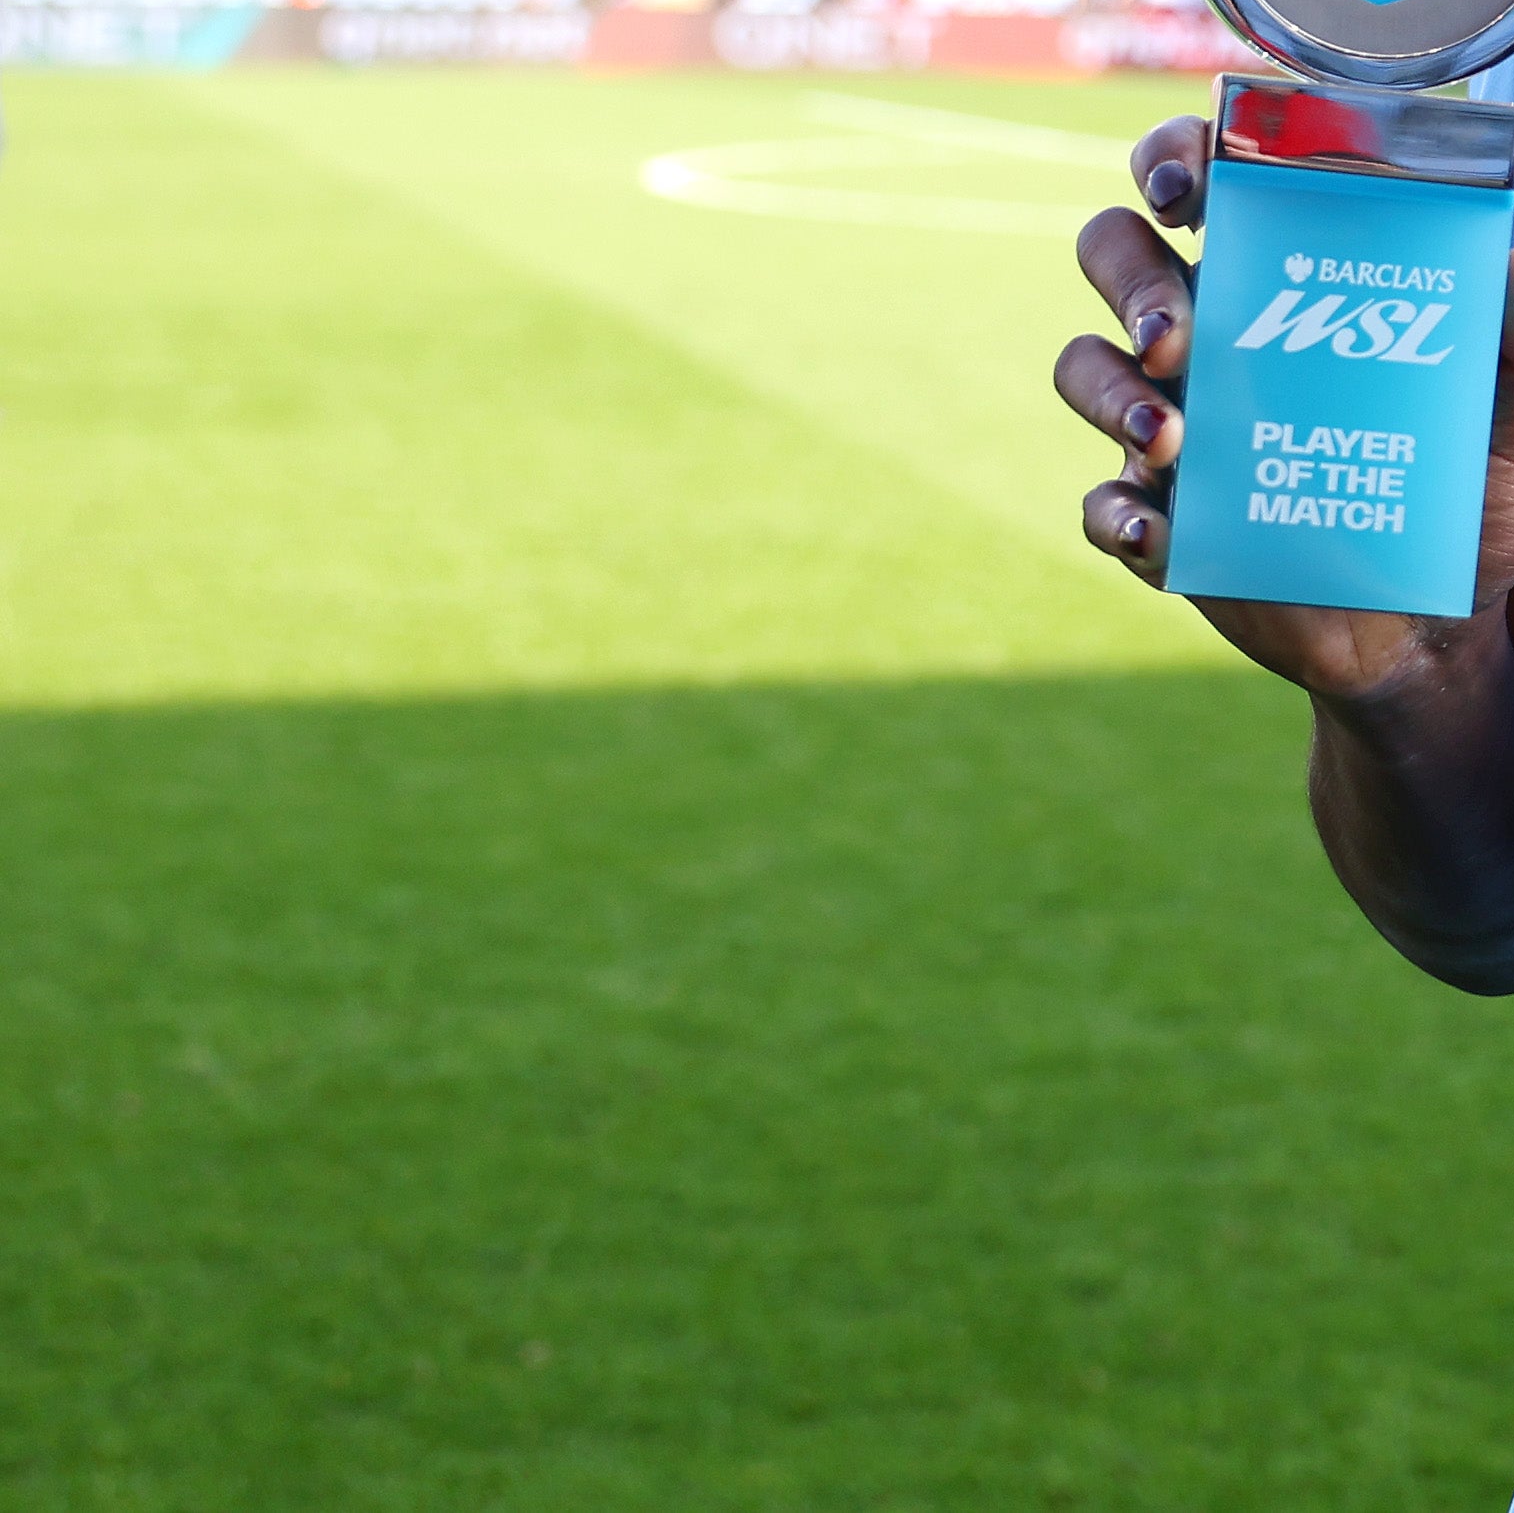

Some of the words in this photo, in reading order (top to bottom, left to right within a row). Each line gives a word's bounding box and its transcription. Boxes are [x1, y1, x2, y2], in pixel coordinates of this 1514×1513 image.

[1319, 258, 1456, 293] BARCLAYS
[1234, 289, 1455, 365] WSL
[1252, 421, 1416, 463] PLAYER
[1256, 457, 1314, 490] OF
[1320, 461, 1406, 497] THE
[1248, 492, 1406, 534] MATCH
